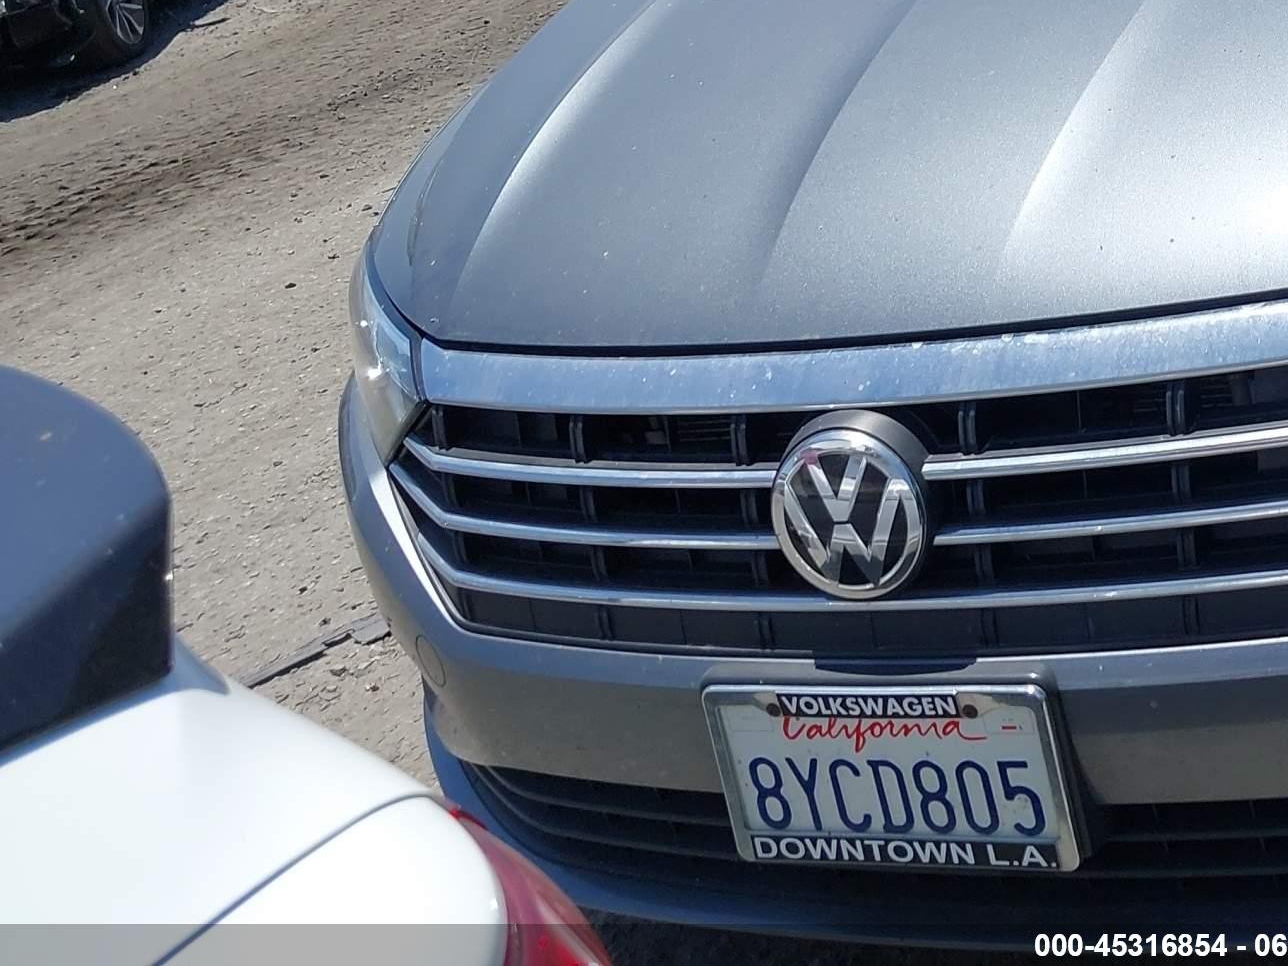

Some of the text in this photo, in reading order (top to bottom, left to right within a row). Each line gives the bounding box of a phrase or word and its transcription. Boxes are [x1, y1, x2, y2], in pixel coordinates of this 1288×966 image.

[780, 694, 958, 717] VOLKSWAGEN
[781, 716, 987, 753] California
[748, 756, 1047, 836] 8YCD805
[754, 836, 1057, 868] DOWNTOWN L.A.
